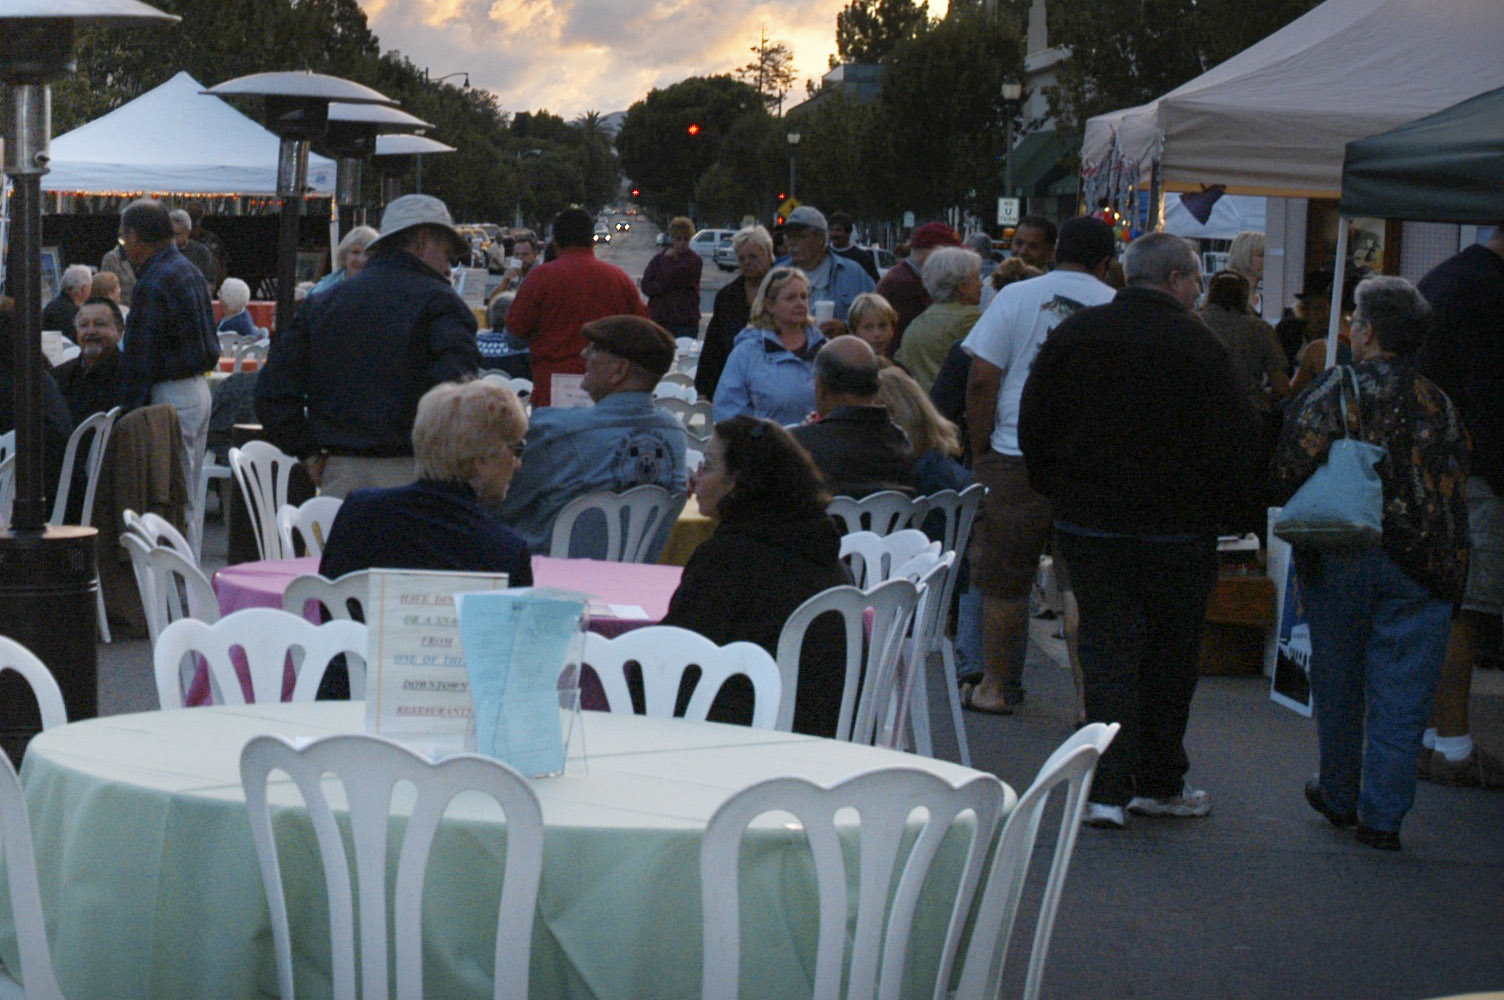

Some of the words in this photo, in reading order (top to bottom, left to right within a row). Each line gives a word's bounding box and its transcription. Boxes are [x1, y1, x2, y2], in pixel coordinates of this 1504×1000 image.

[1005, 207, 1012, 216] U
[400, 593, 427, 606] HAVE
[435, 595, 454, 606] DIN
[403, 615, 419, 626] OR
[436, 616, 460, 627] SNA
[421, 636, 453, 647] FROM
[393, 655, 417, 666] ONE
[422, 655, 437, 666] OF
[402, 680, 468, 693] DOWNTOWN
